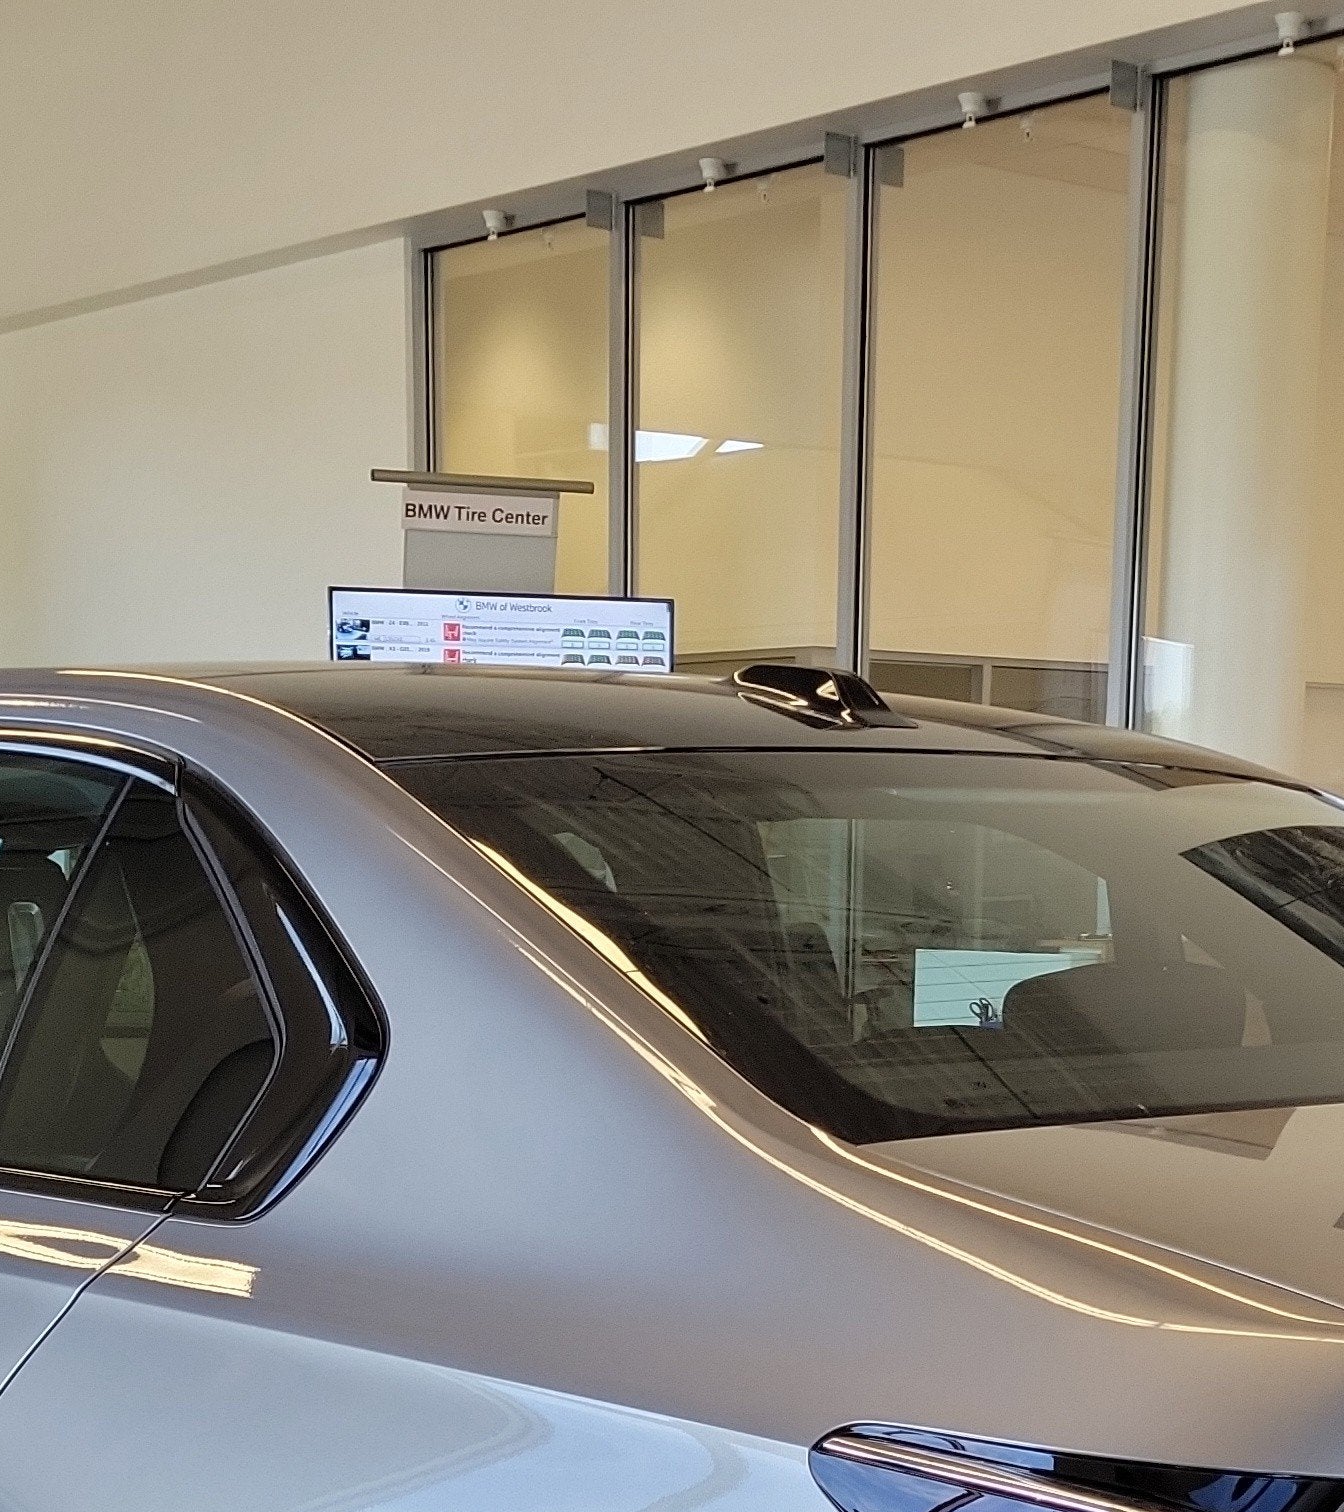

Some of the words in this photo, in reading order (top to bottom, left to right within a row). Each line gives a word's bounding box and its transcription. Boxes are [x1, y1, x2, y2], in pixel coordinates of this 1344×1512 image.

[405, 503, 451, 520] BMW
[454, 505, 487, 523] Tire
[492, 508, 549, 526] Center
[476, 601, 498, 611] BMW
[499, 602, 509, 612] of
[510, 604, 553, 613] Westbrook
